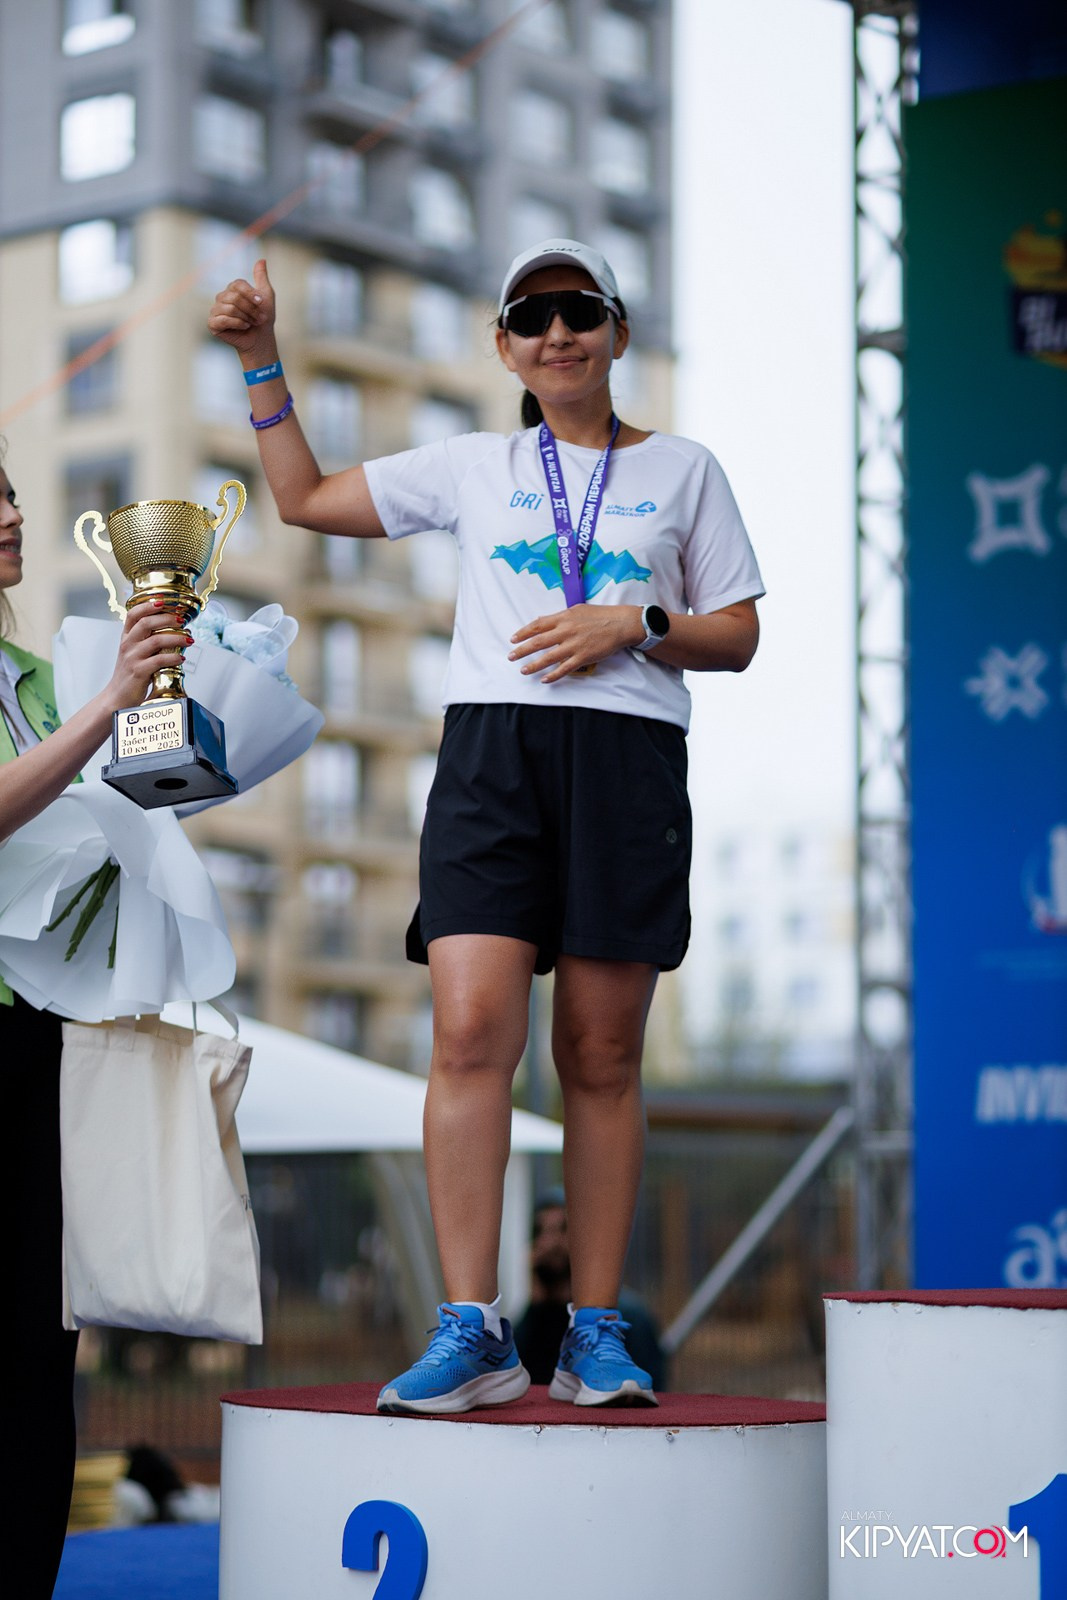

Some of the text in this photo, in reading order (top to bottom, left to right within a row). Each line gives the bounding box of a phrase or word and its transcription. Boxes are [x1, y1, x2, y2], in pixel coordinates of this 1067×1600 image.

[578, 503, 597, 552] ДОБРЫМ
[560, 548, 571, 575] GROUP
[142, 708, 174, 721] GROUP
[138, 721, 176, 734] место
[121, 737, 147, 747] Забег
[160, 729, 179, 740] RUN
[122, 746, 133, 755] 10
[157, 739, 180, 750] 2025
